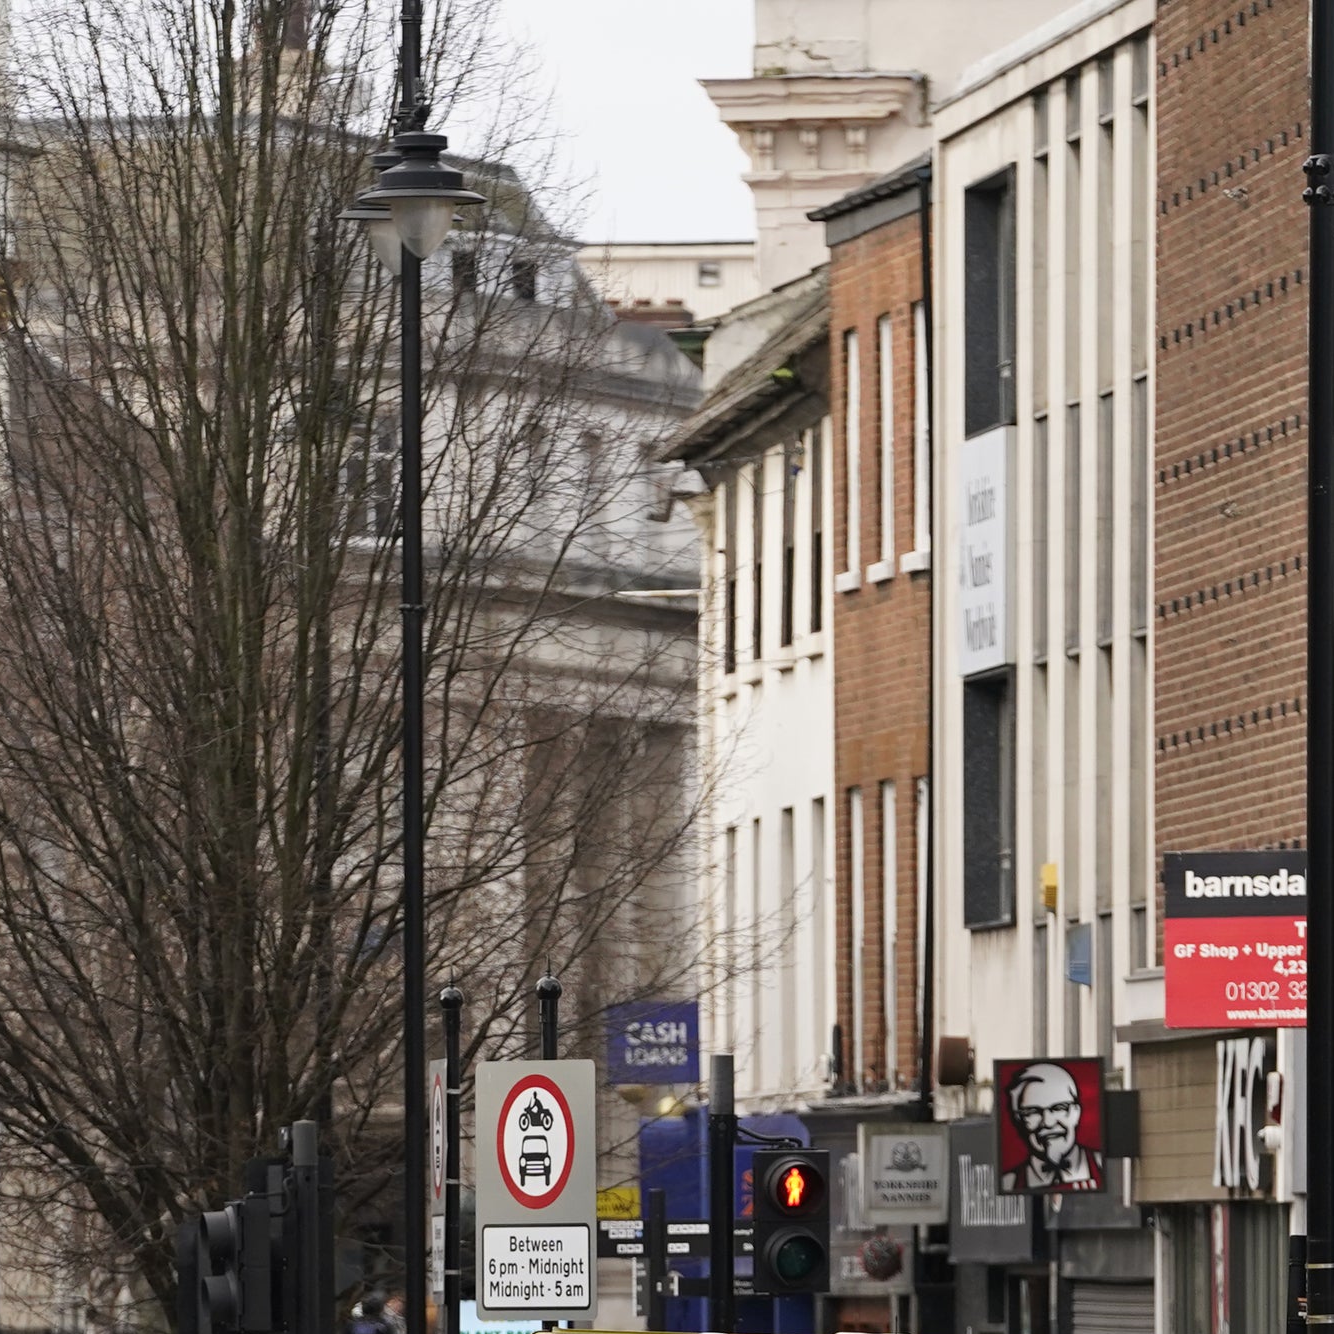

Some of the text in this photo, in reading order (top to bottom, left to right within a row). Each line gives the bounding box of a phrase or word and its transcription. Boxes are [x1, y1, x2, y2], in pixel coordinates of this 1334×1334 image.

[1184, 869, 1307, 898] barnsda
[1174, 943, 1196, 958] GF
[1199, 942, 1239, 960] Shop
[1256, 942, 1304, 960] Upper
[1225, 981, 1280, 1000] 01302
[625, 1021, 687, 1046] CASH
[624, 1046, 688, 1066] LOANS
[1212, 1036, 1266, 1191] KFC
[873, 1179, 938, 1190] YORKSHIRE
[881, 1193, 932, 1203] NANNIES
[509, 1236, 563, 1252] Between
[529, 1258, 584, 1277] Midnight
[489, 1281, 544, 1300] Midnight
